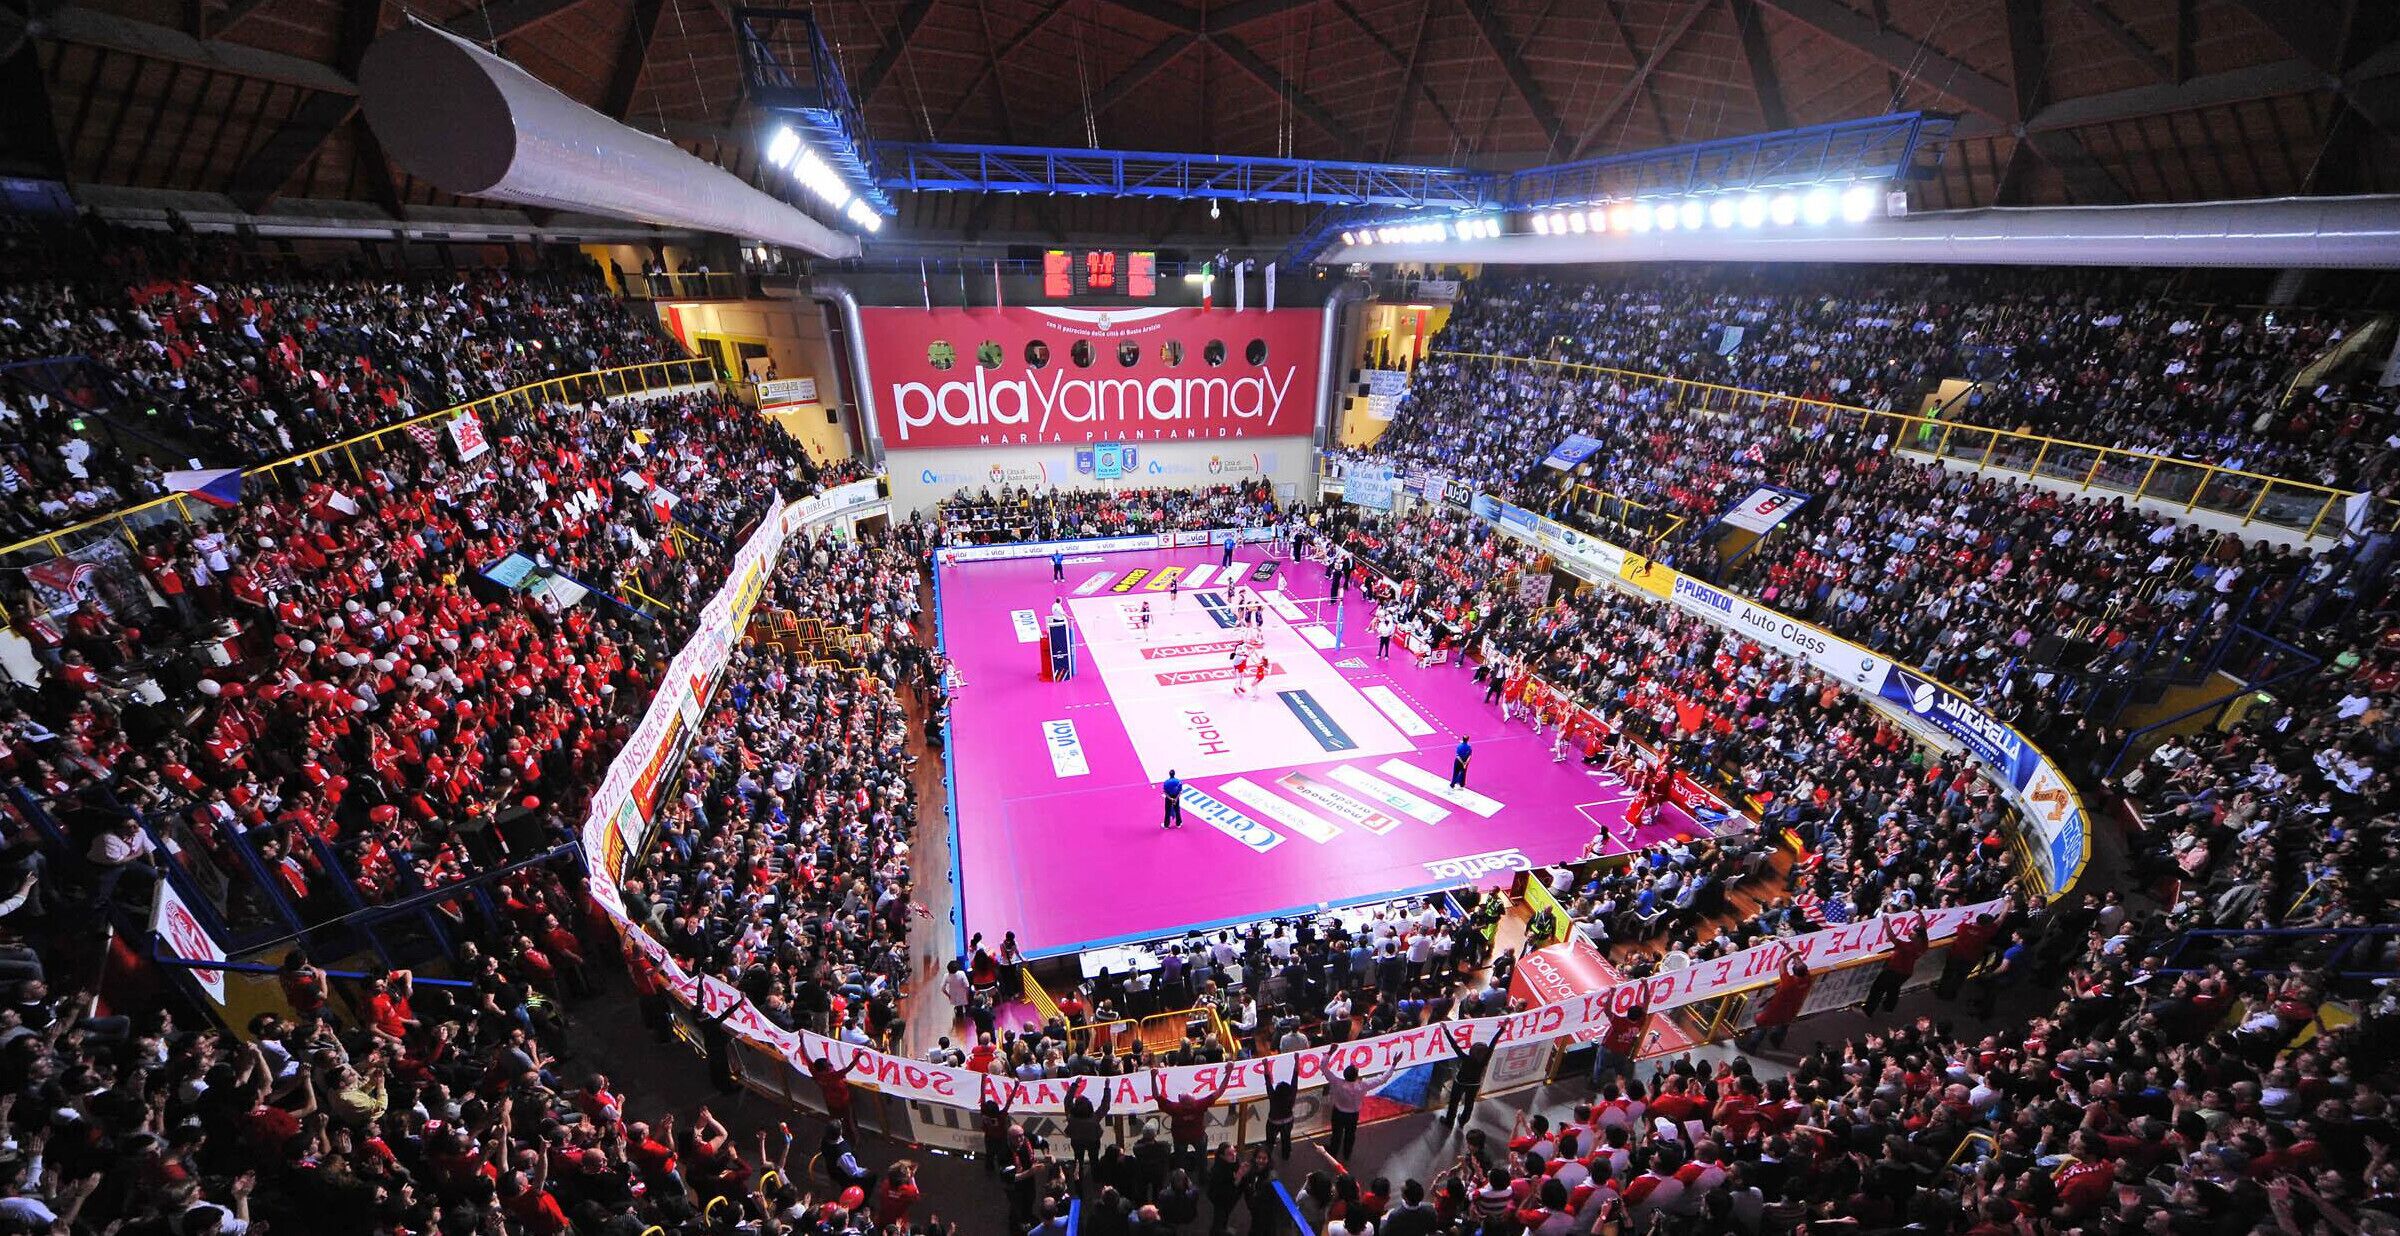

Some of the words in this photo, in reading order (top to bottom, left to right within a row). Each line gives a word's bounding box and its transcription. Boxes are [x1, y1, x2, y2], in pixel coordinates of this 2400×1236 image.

[893, 365, 1296, 440] palayamamay
[980, 431, 1062, 444] MARIA
[1086, 427, 1244, 441] PIANTANIDA
[1684, 580, 1734, 614] PLASTICOL
[1741, 608, 1776, 632] Auto
[1781, 624, 1827, 655] Class
[1184, 710, 1231, 755] Haier
[1427, 853, 1532, 881] Gerflor
